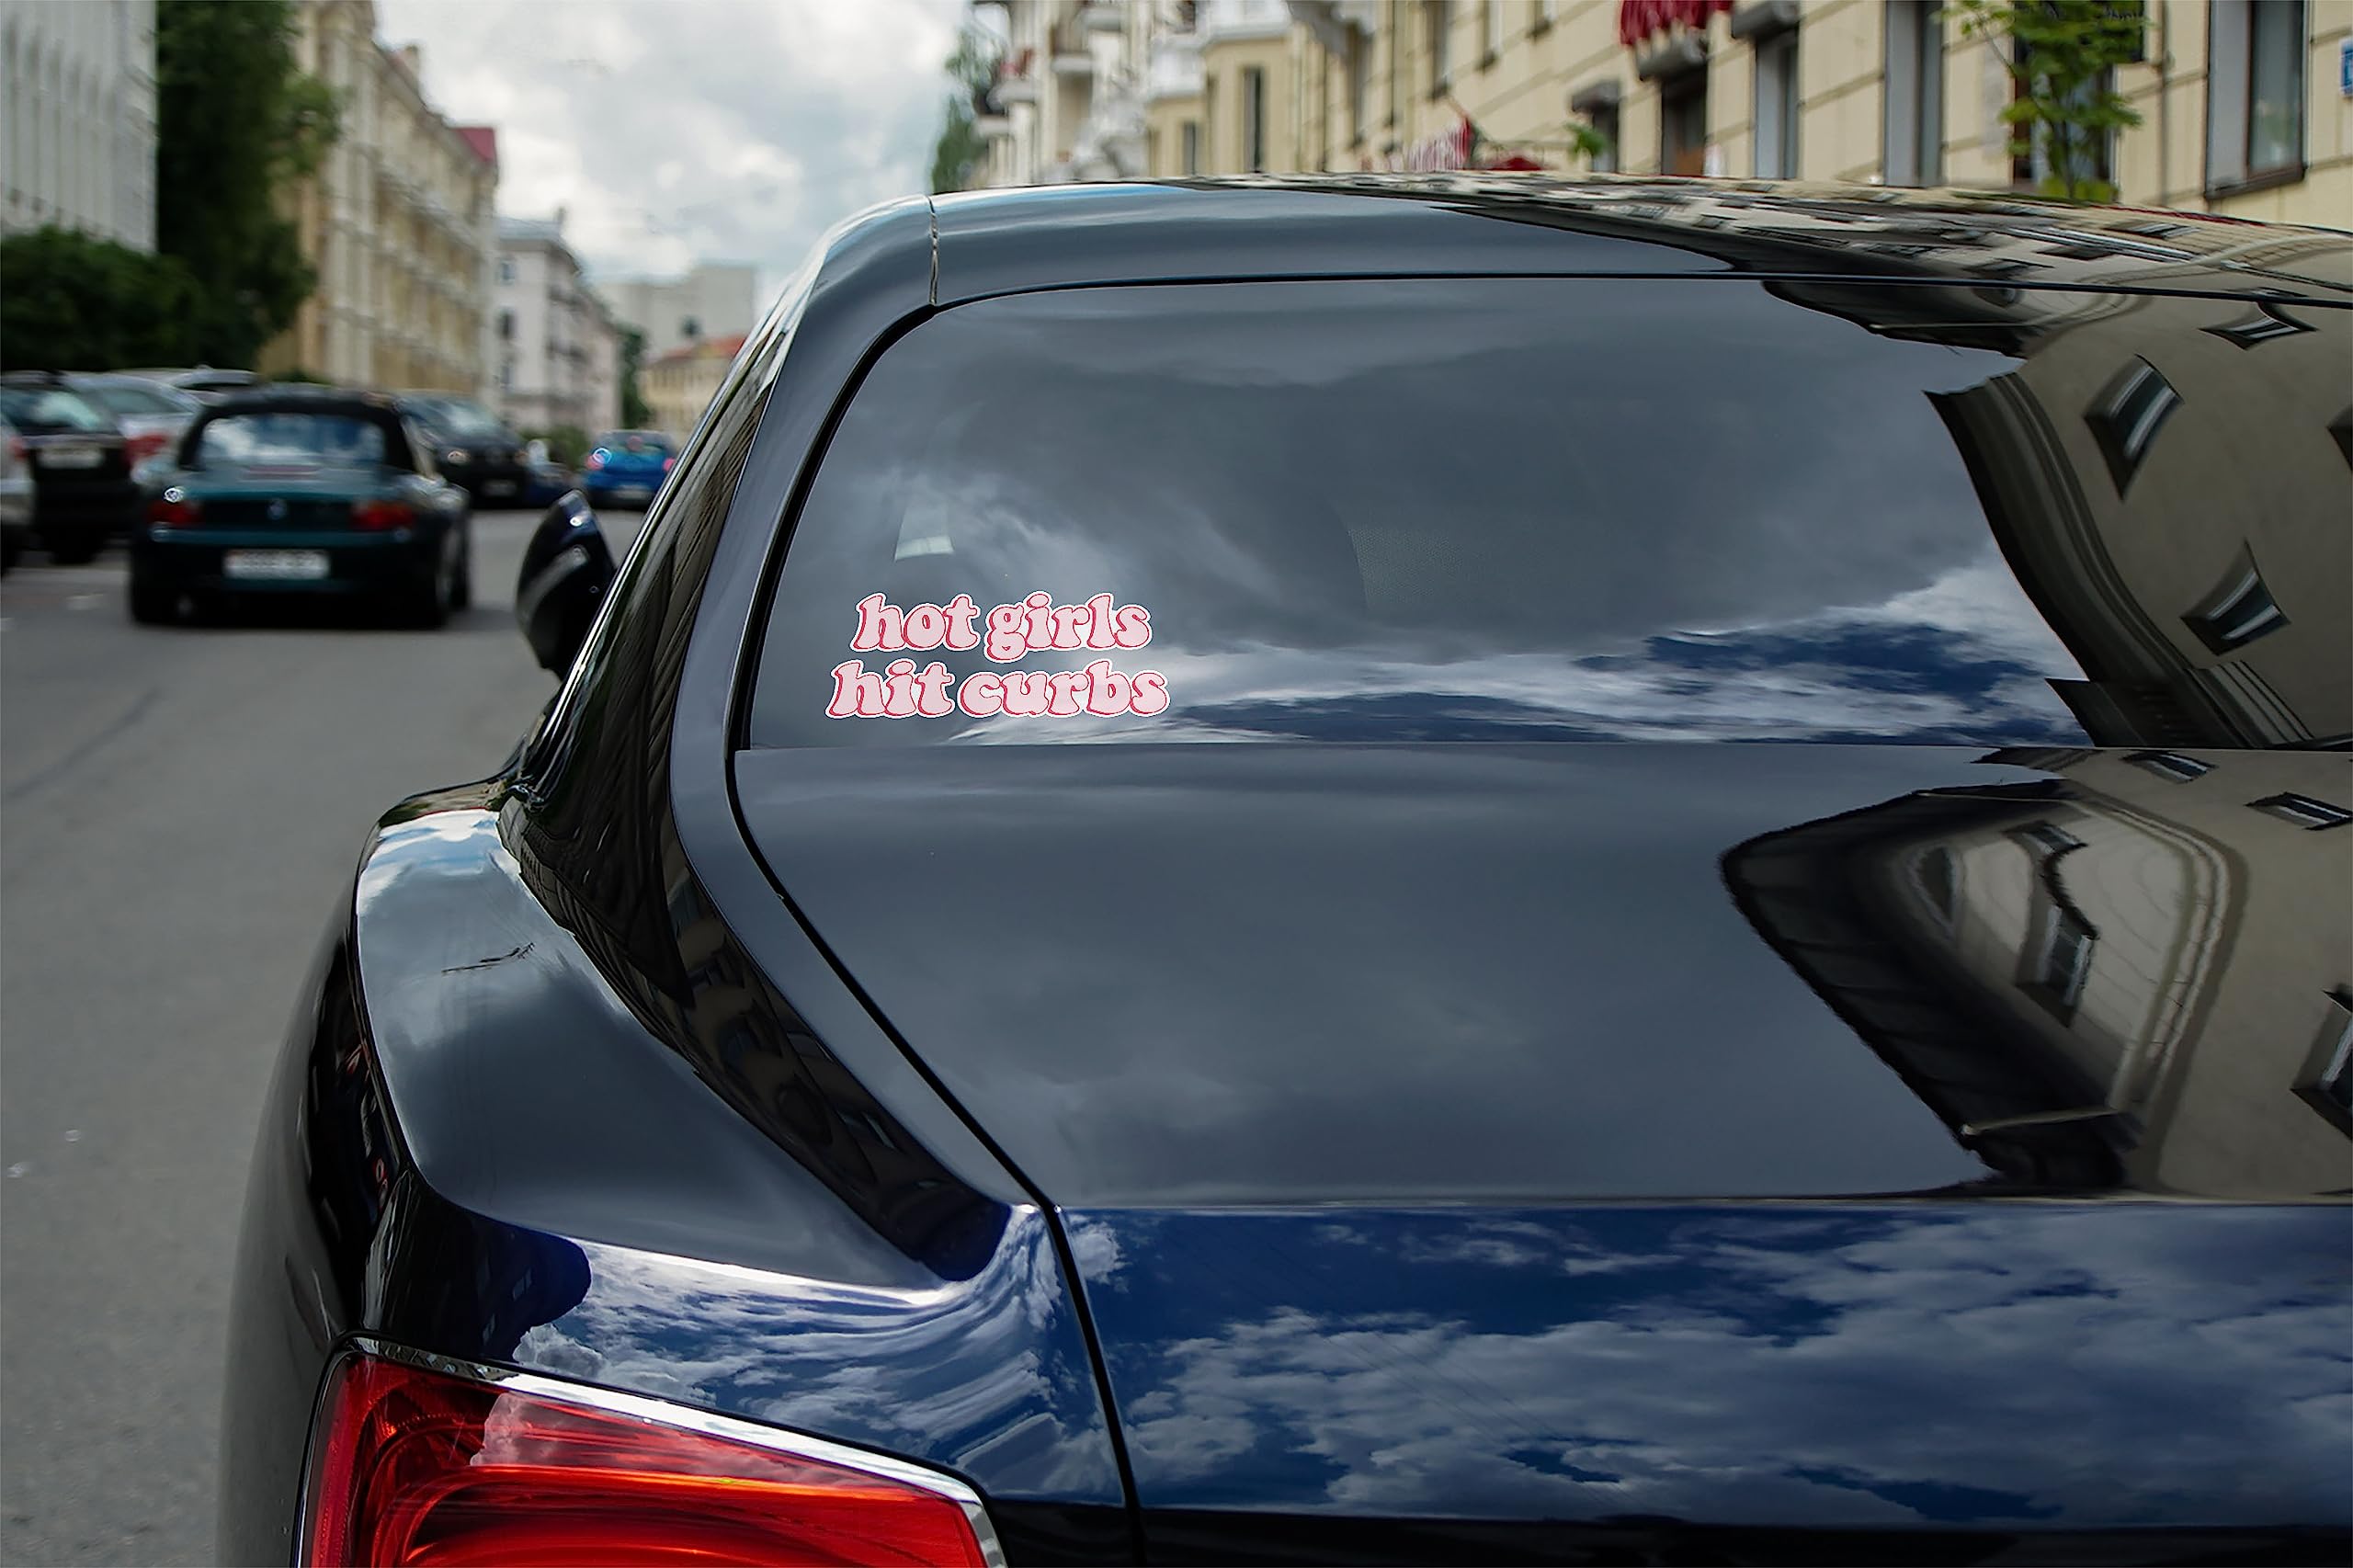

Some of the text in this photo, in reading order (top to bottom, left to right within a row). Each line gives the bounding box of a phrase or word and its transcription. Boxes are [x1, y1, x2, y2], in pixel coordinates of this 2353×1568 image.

[852, 592, 1152, 662] hot girls
[826, 660, 1169, 717] hit curbs
